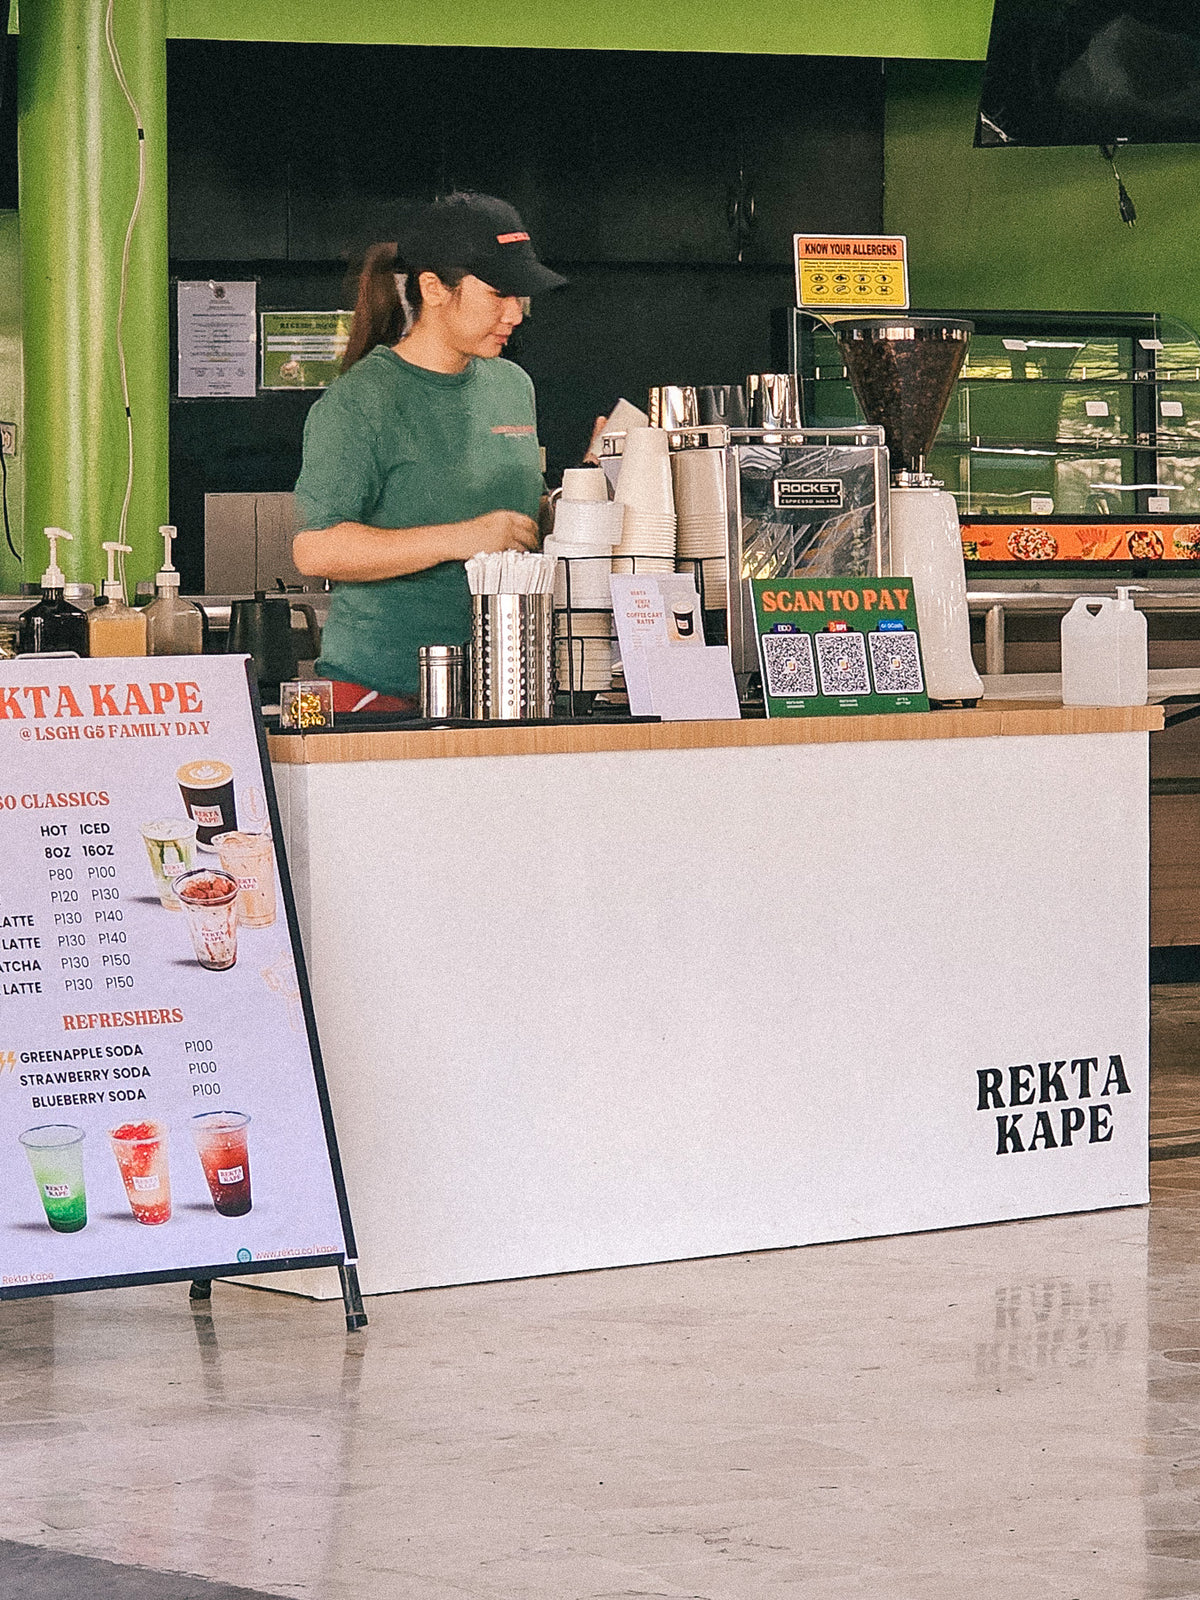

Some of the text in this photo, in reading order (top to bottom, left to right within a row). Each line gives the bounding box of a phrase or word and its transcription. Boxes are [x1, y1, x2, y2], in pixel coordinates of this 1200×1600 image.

[804, 243, 897, 256] KNOW YOUR ALLERGENS
[780, 483, 840, 493] ROCKET
[762, 588, 910, 613] SCAN TO PAY
[89, 681, 203, 717] KAPE
[20, 721, 210, 741] @ LSGH G5 FAMILY DAY
[0, 791, 110, 810] O CLASSICS
[40, 823, 110, 837] HOT ICED
[45, 845, 114, 859] 8OZ 16OZ
[49, 866, 116, 880] P80 P100
[50, 888, 120, 902] P120 P130
[0, 910, 123, 928] ATTE P130 P140
[2, 931, 127, 950] LATTE P130 P140
[61, 956, 89, 969] P130
[102, 953, 131, 966] P150
[3, 975, 134, 995] LATTE P130 P150
[62, 1008, 184, 1031] REFRESHERS
[20, 1039, 214, 1064] GREENAPPLE SODA P100
[19, 1061, 218, 1087] STRAWBERRY SODA P100
[976, 1054, 1131, 1111] REKTA
[32, 1083, 221, 1109] BLUEBERRY SODA P100
[996, 1103, 1114, 1156] KAPE
[2, 1272, 54, 1285] Rekta Kape
